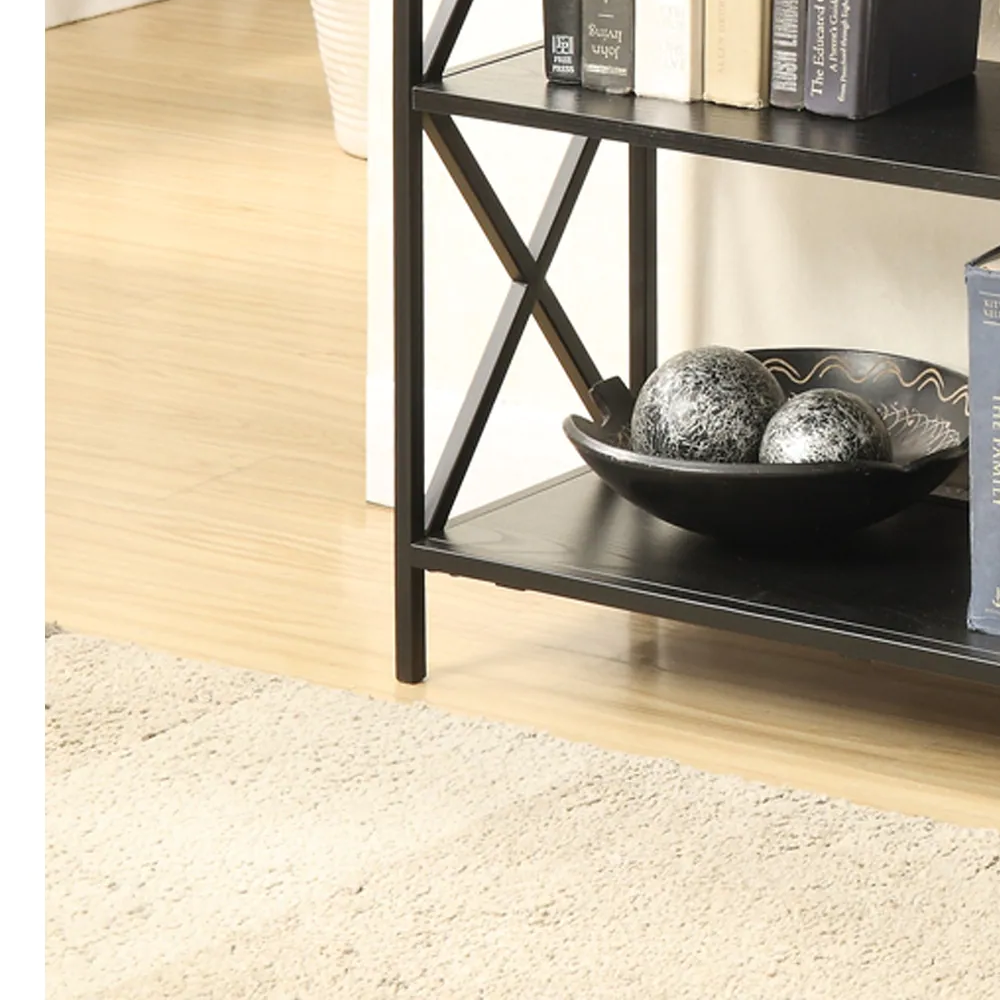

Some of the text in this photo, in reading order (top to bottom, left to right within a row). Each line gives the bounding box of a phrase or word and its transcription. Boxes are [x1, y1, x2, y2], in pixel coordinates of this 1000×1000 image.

[588, 23, 624, 43] Irving
[812, 5, 826, 67] Educated
[591, 43, 622, 60] John
[772, 50, 799, 93] RUSH
[810, 67, 825, 97] The
